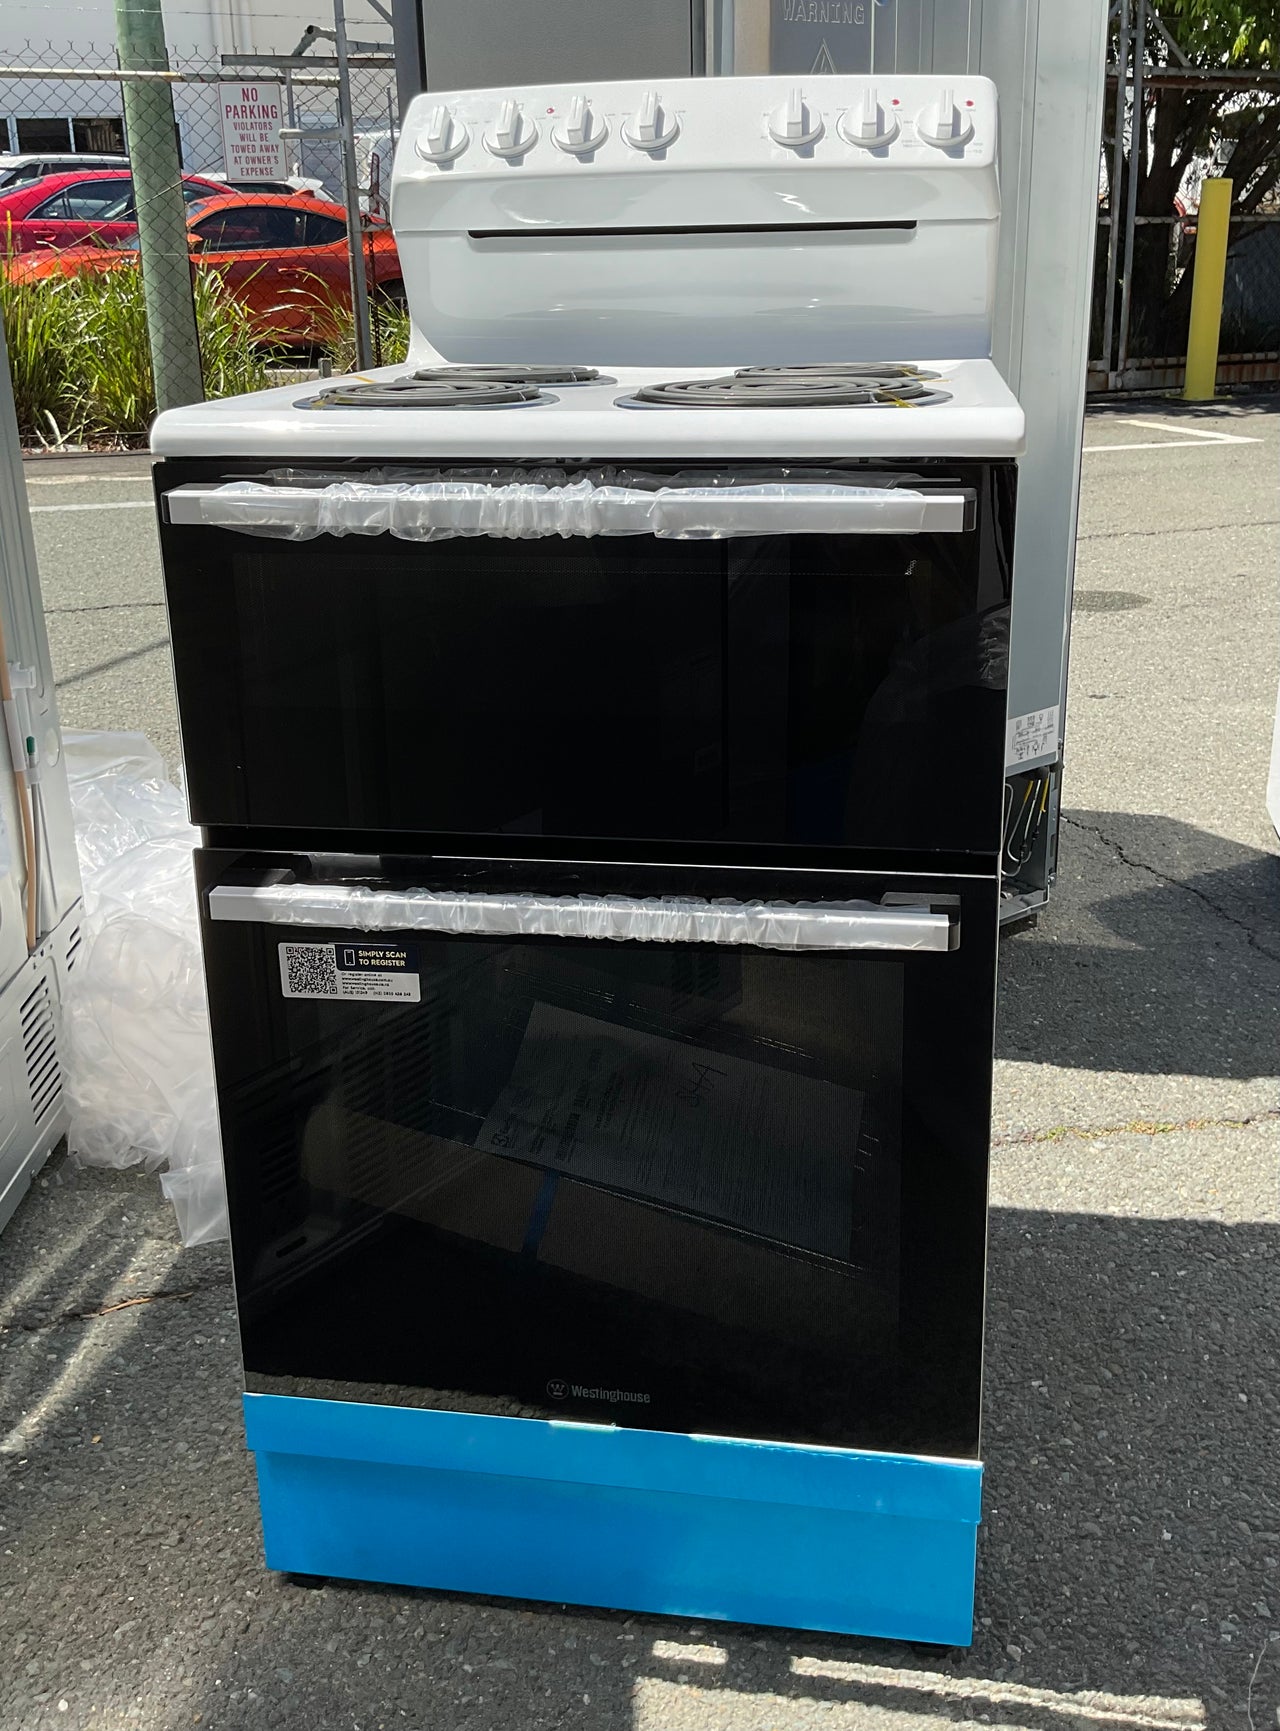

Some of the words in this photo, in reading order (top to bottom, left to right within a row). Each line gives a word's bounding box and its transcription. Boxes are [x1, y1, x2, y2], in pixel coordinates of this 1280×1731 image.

[782, 0, 865, 24] WARNING
[241, 87, 258, 102] NO
[225, 105, 278, 119] PARKING
[233, 122, 273, 131] VIOLATORS
[239, 133, 257, 142] WILL
[260, 133, 269, 142] BE
[230, 145, 257, 154] TOWED
[260, 145, 279, 154] AWAY
[233, 156, 242, 165] AT
[245, 156, 279, 165] OWNER'S
[240, 167, 274, 176] EXPENSE
[571, 1384, 651, 1403] Westinghouse
